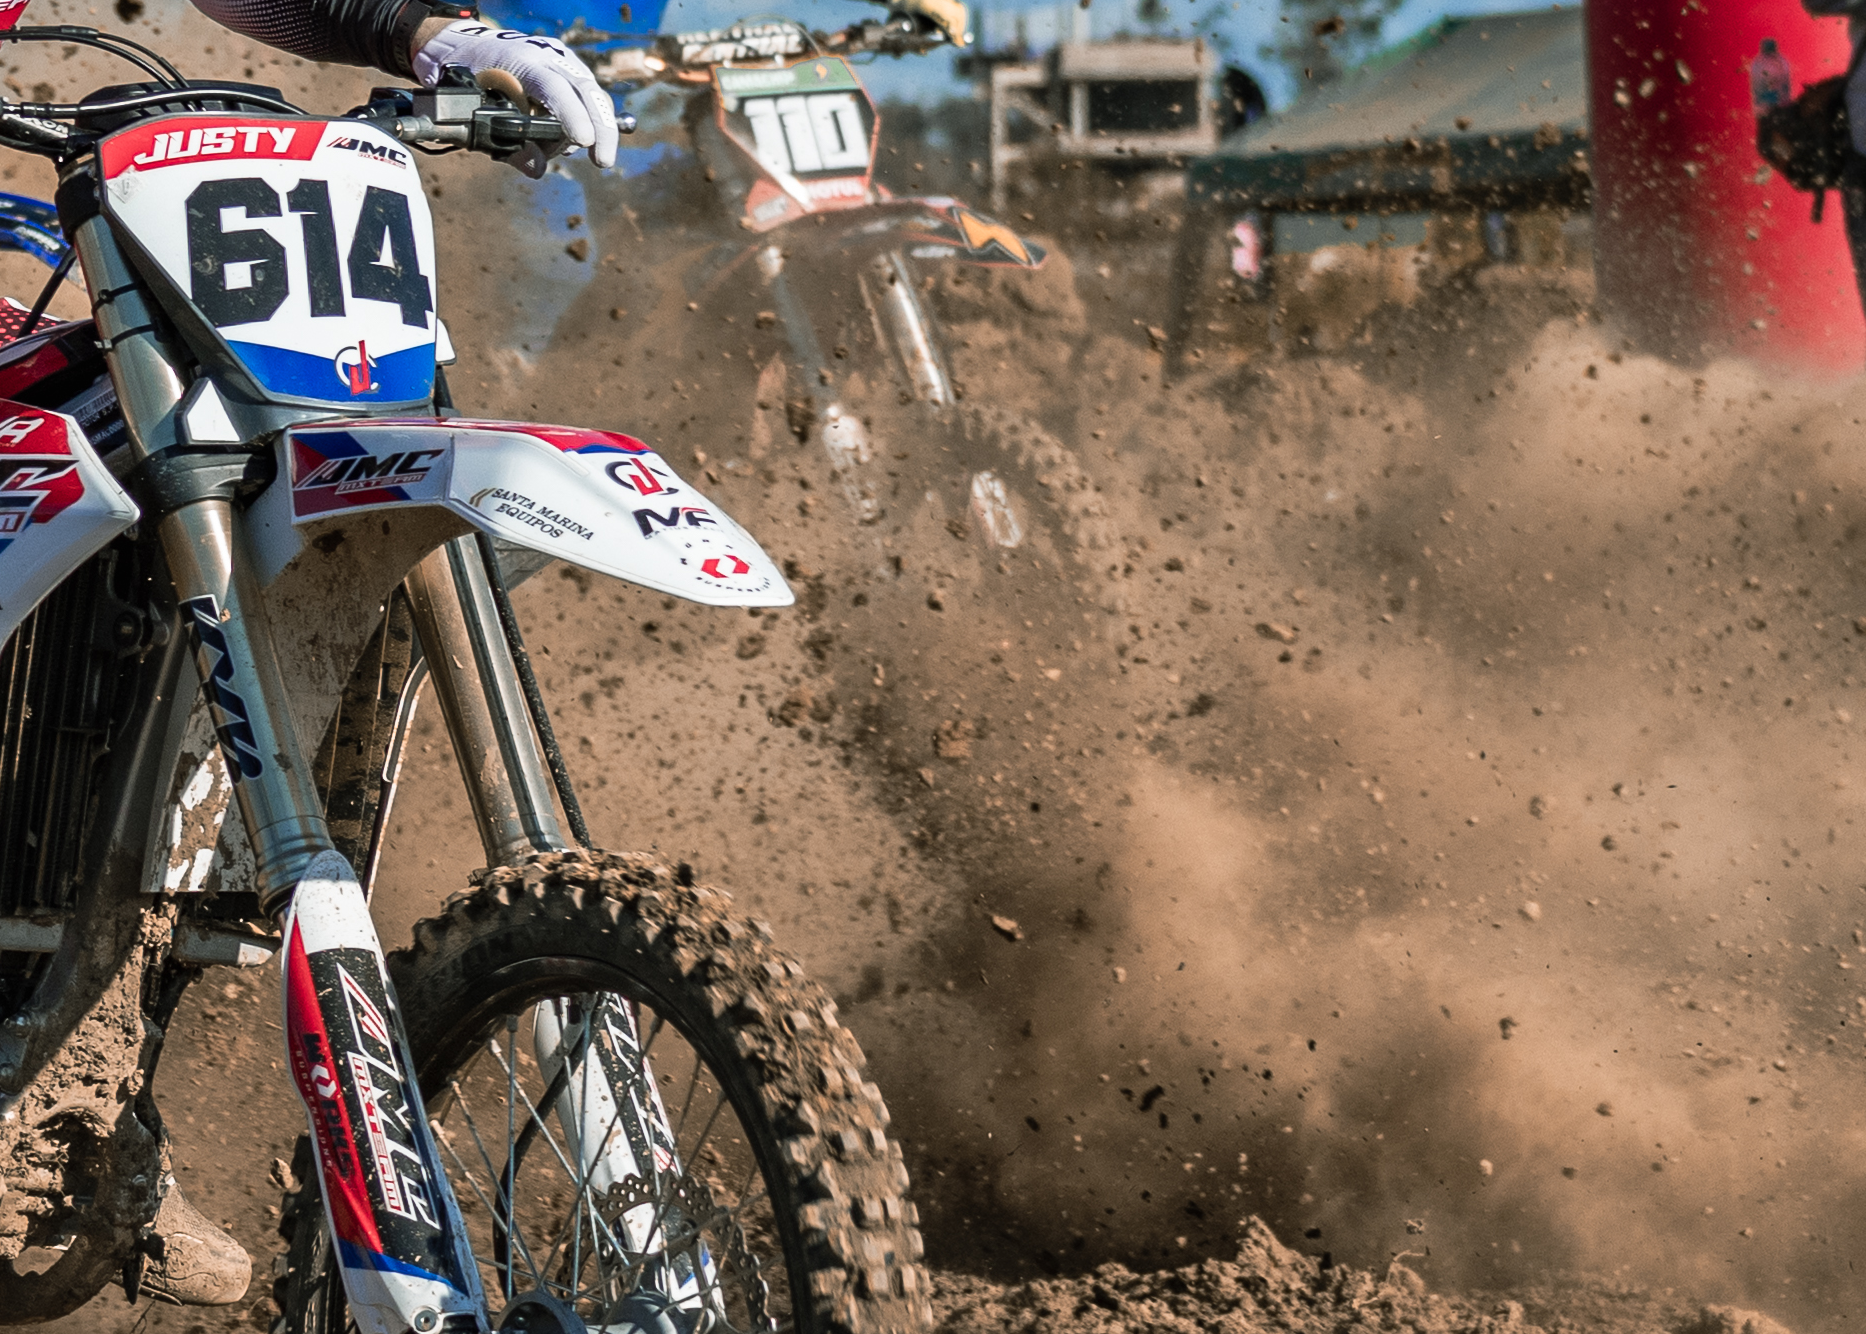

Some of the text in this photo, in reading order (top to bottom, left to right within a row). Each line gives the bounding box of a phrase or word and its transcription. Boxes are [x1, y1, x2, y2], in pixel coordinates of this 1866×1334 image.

[133, 127, 299, 166] JUSTY
[327, 136, 408, 167] JMC
[743, 92, 871, 174] 110
[184, 176, 435, 331] 614
[293, 448, 446, 490] JMC
[491, 487, 595, 542] SANTA MARINA
[494, 502, 565, 540] EQUIPOS
